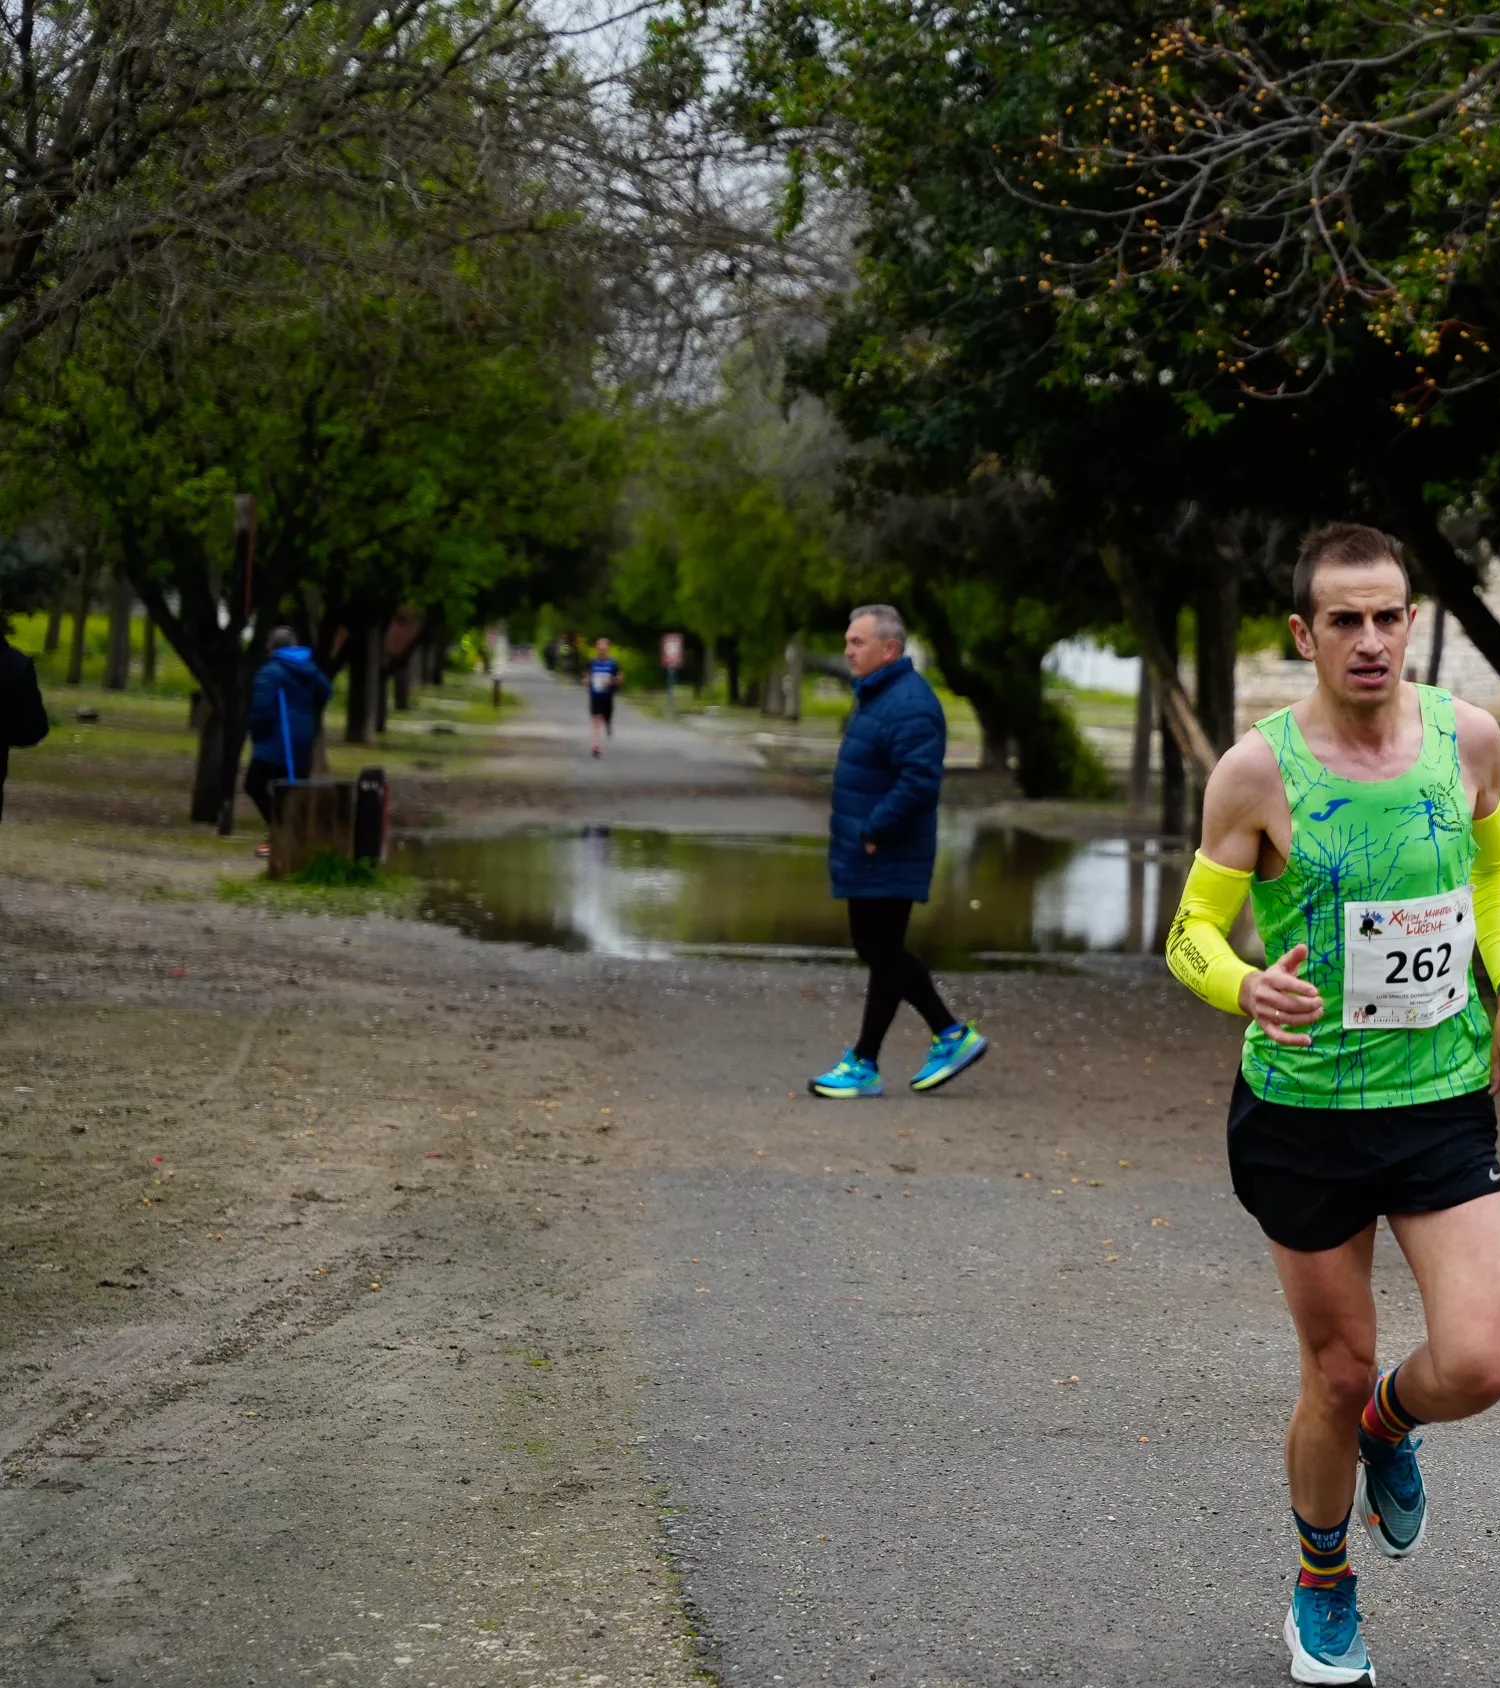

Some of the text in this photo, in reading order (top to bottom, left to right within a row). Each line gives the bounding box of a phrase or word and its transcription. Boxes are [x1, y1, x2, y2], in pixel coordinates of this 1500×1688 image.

[1406, 919, 1446, 936] LUCENA
[1180, 938, 1208, 976] CARRERA
[1386, 942, 1452, 984] 262
[1312, 1531, 1340, 1540] NEVER
[1316, 1540, 1338, 1548] STOP
